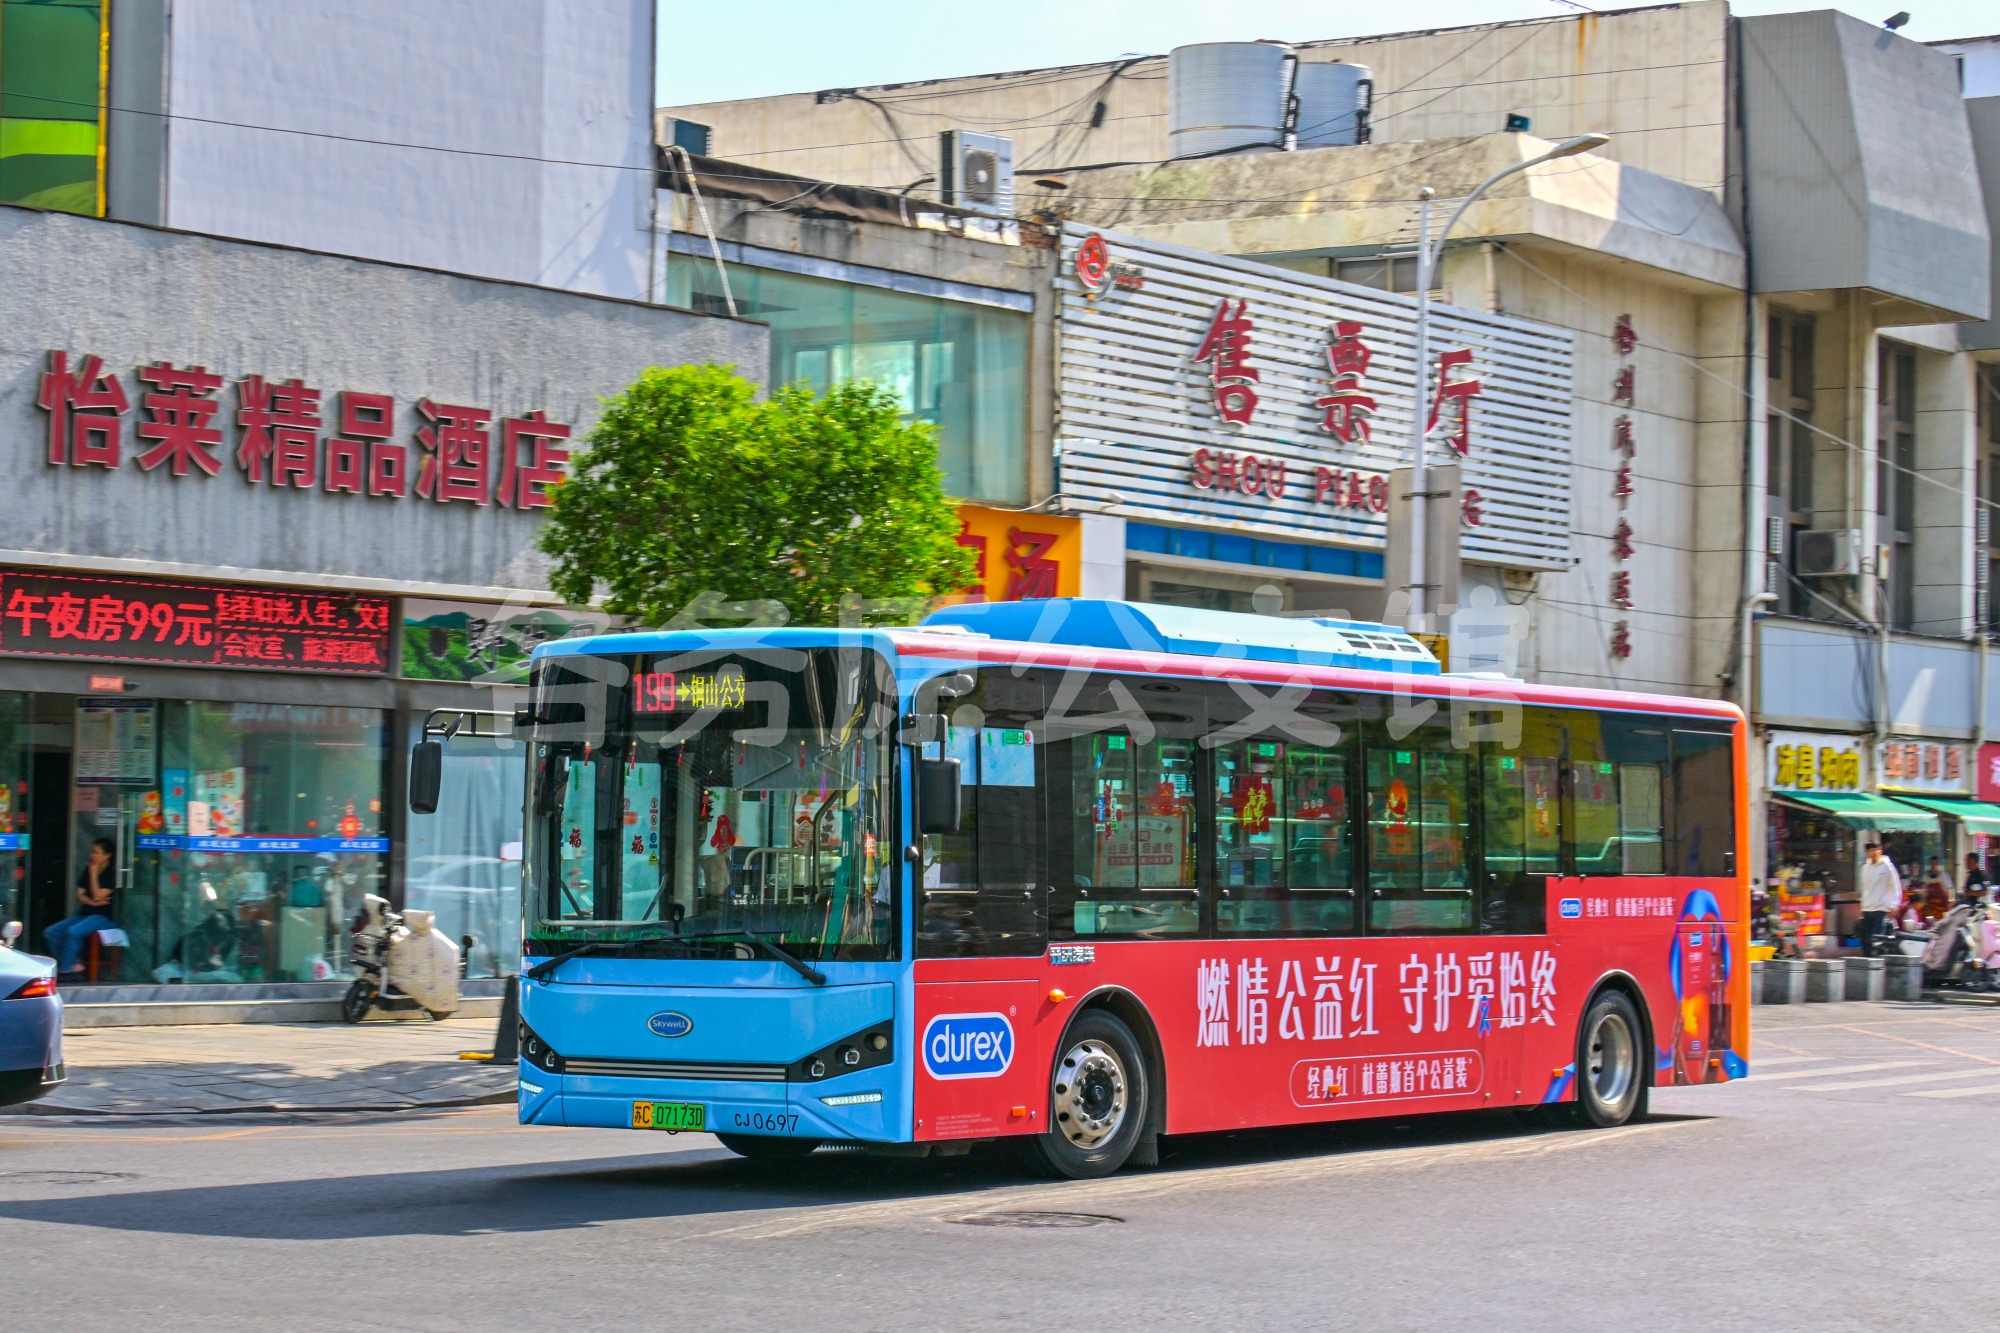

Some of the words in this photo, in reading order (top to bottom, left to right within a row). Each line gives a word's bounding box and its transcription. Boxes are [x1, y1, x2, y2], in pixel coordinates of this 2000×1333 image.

[1194, 297, 1482, 459] 售票厅
[38, 349, 571, 510] 怡莱精品酒店
[1192, 447, 1286, 499] SHOU
[1313, 466, 1388, 513] PIAO
[5, 588, 213, 647] 午夜房99元
[634, 672, 675, 712] 199
[690, 674, 745, 709] 铜山公交
[652, 1019, 686, 1029] Skywell
[1197, 955, 1379, 1048] 燃情公益红
[931, 1023, 1009, 1068] durex
[1307, 1065, 1349, 1099] 经典红
[734, 1112, 799, 1132] CJ0697
